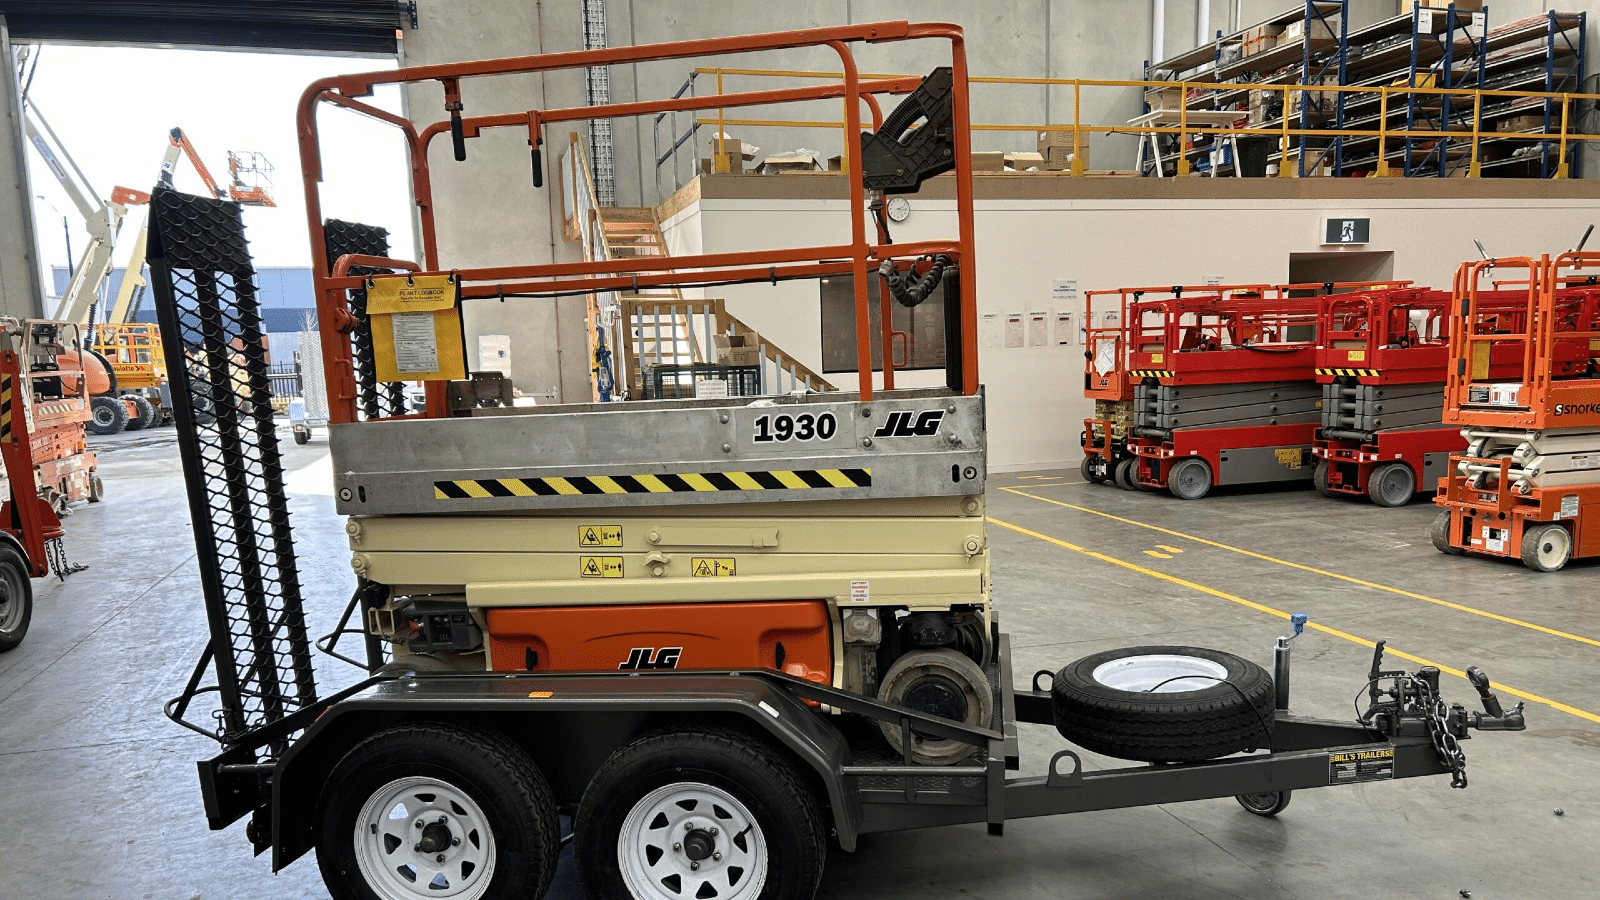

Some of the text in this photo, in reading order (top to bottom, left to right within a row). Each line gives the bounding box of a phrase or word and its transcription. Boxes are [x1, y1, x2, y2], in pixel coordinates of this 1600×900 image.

[1564, 402, 1600, 414] snorke
[753, 411, 838, 443] 1930
[873, 409, 946, 438] JLG
[618, 646, 683, 669] JLG
[1334, 750, 1390, 762] BILL'S TRAILERS
